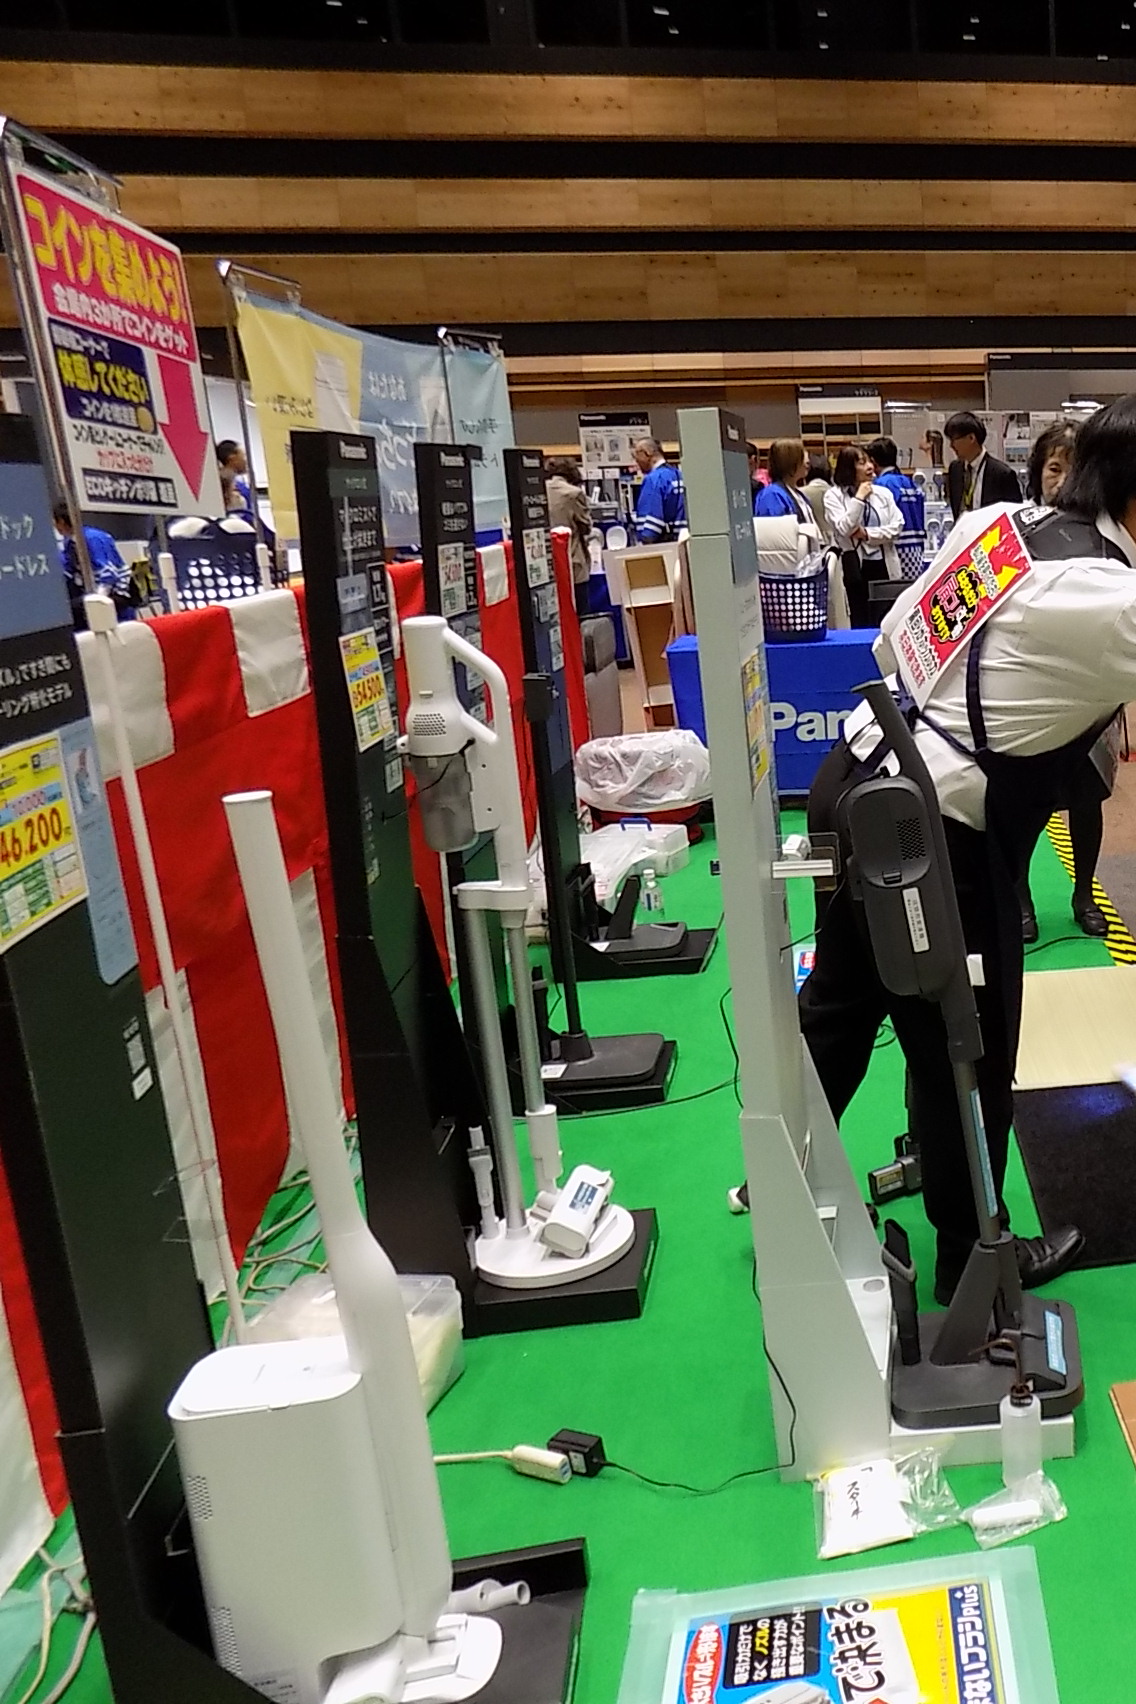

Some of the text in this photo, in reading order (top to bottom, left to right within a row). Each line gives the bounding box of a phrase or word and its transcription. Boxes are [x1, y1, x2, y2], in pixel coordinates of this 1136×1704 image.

[0, 554, 49, 581] ードレス
[734, 1623, 753, 1685] 吸引力だけで
[753, 1659, 769, 1682] なく
